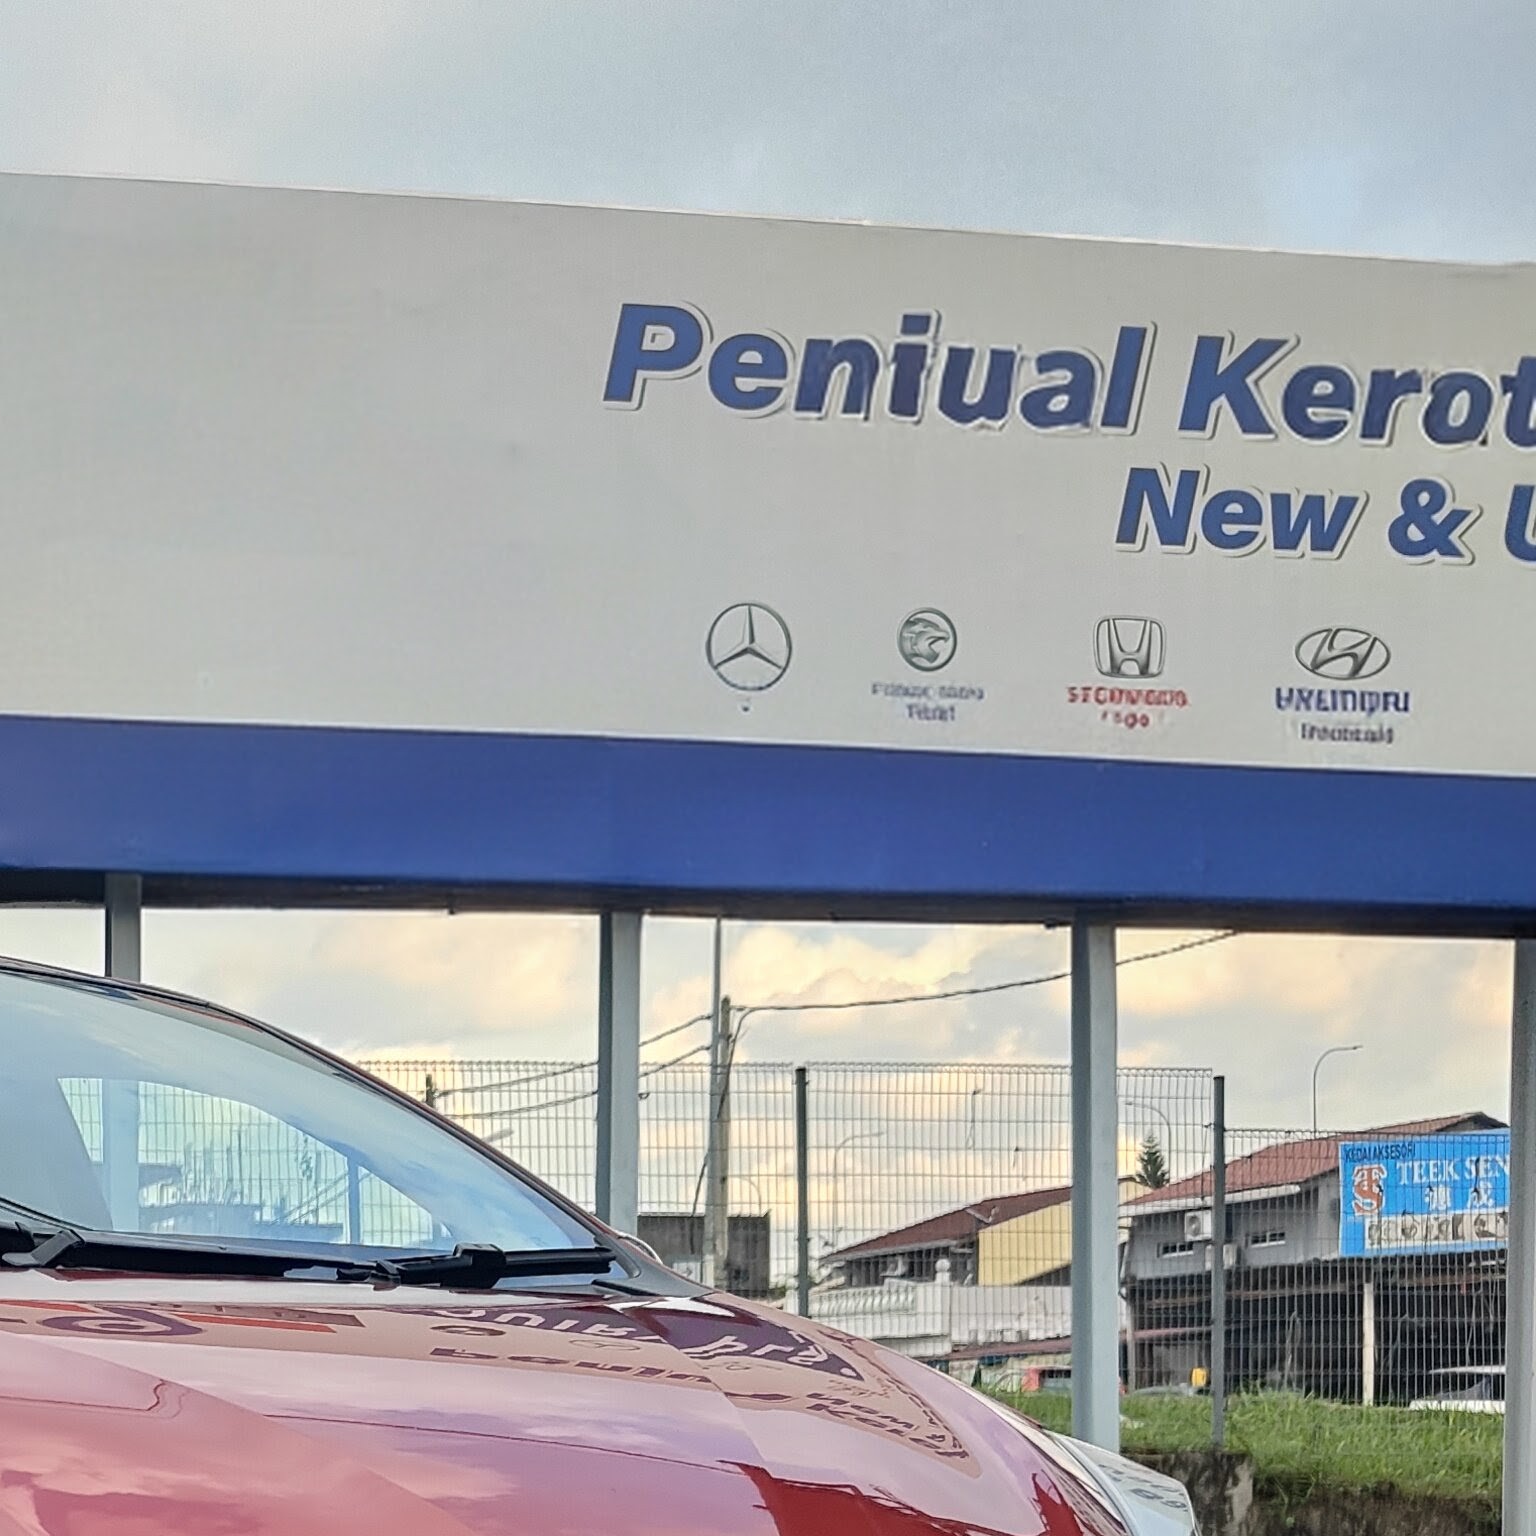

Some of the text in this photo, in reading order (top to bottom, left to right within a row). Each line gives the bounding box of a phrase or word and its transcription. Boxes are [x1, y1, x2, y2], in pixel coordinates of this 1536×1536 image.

[602, 302, 1155, 433] Peniual
[1115, 466, 1366, 556] New
[1387, 478, 1479, 561] &
